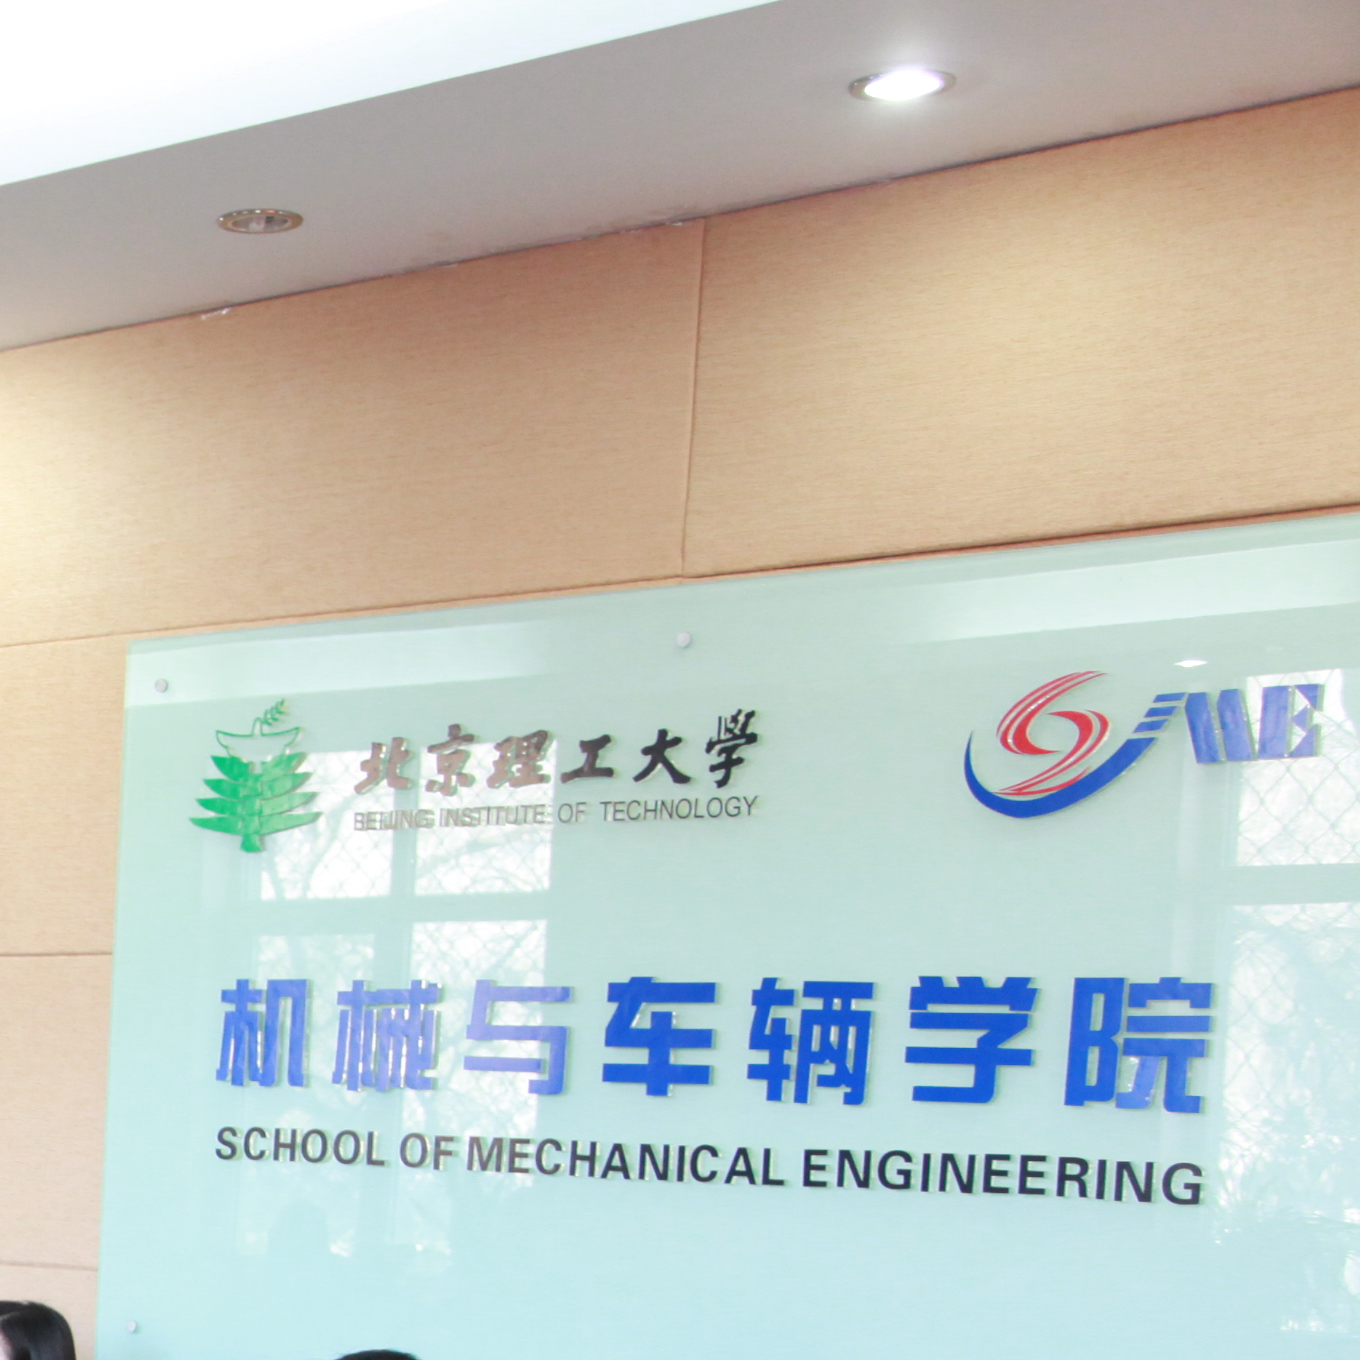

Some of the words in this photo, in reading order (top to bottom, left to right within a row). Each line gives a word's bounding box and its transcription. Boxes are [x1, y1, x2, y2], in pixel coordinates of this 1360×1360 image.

[354, 808, 434, 832] BEIJING
[439, 804, 544, 828] INSTITUTE
[558, 802, 586, 824] OF
[600, 796, 758, 823] TECHNOLOGY
[216, 975, 1215, 1114] 机械与车辆学院
[215, 1126, 386, 1169] SCHOOL
[398, 1133, 462, 1174] OF
[467, 1135, 787, 1189] MECHANICAL
[802, 1148, 1206, 1208] ENGINEERING
